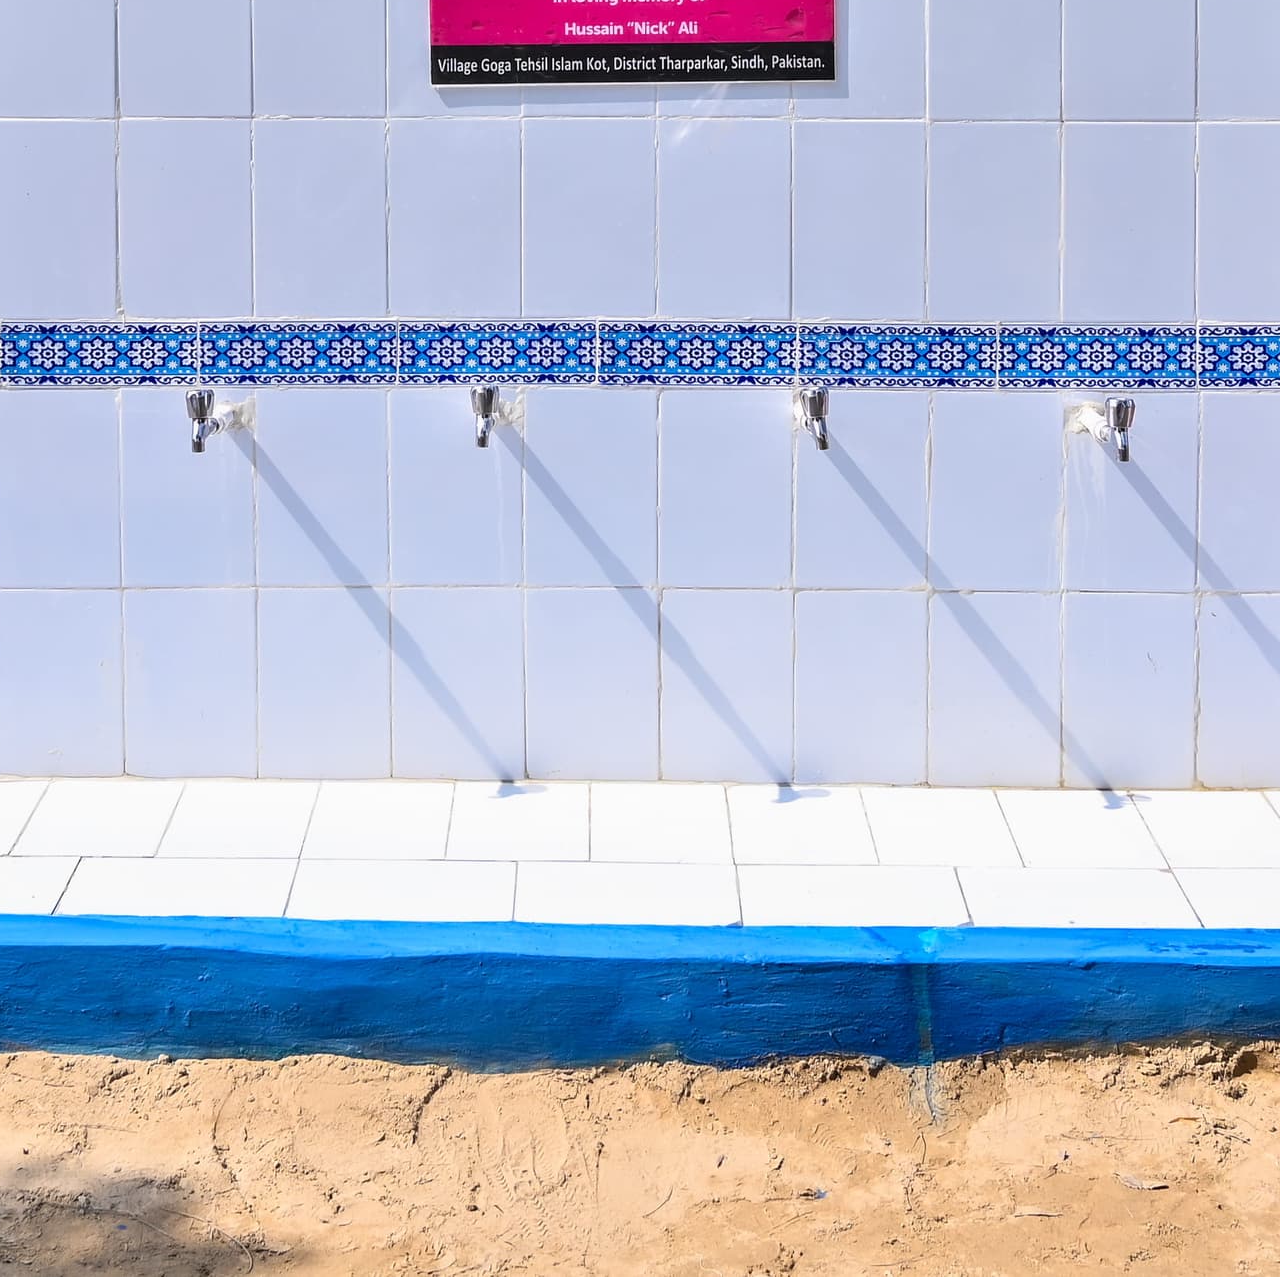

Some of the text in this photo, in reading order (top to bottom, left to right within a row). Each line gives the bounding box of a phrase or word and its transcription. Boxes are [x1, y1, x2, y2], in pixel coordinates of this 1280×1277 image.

[565, 22, 624, 35] Hussain
[678, 21, 698, 34] Ali
[438, 54, 825, 75] Village Goga Tehsil Islam Kot, District Tharparkar, Sindh, Pakistan.
